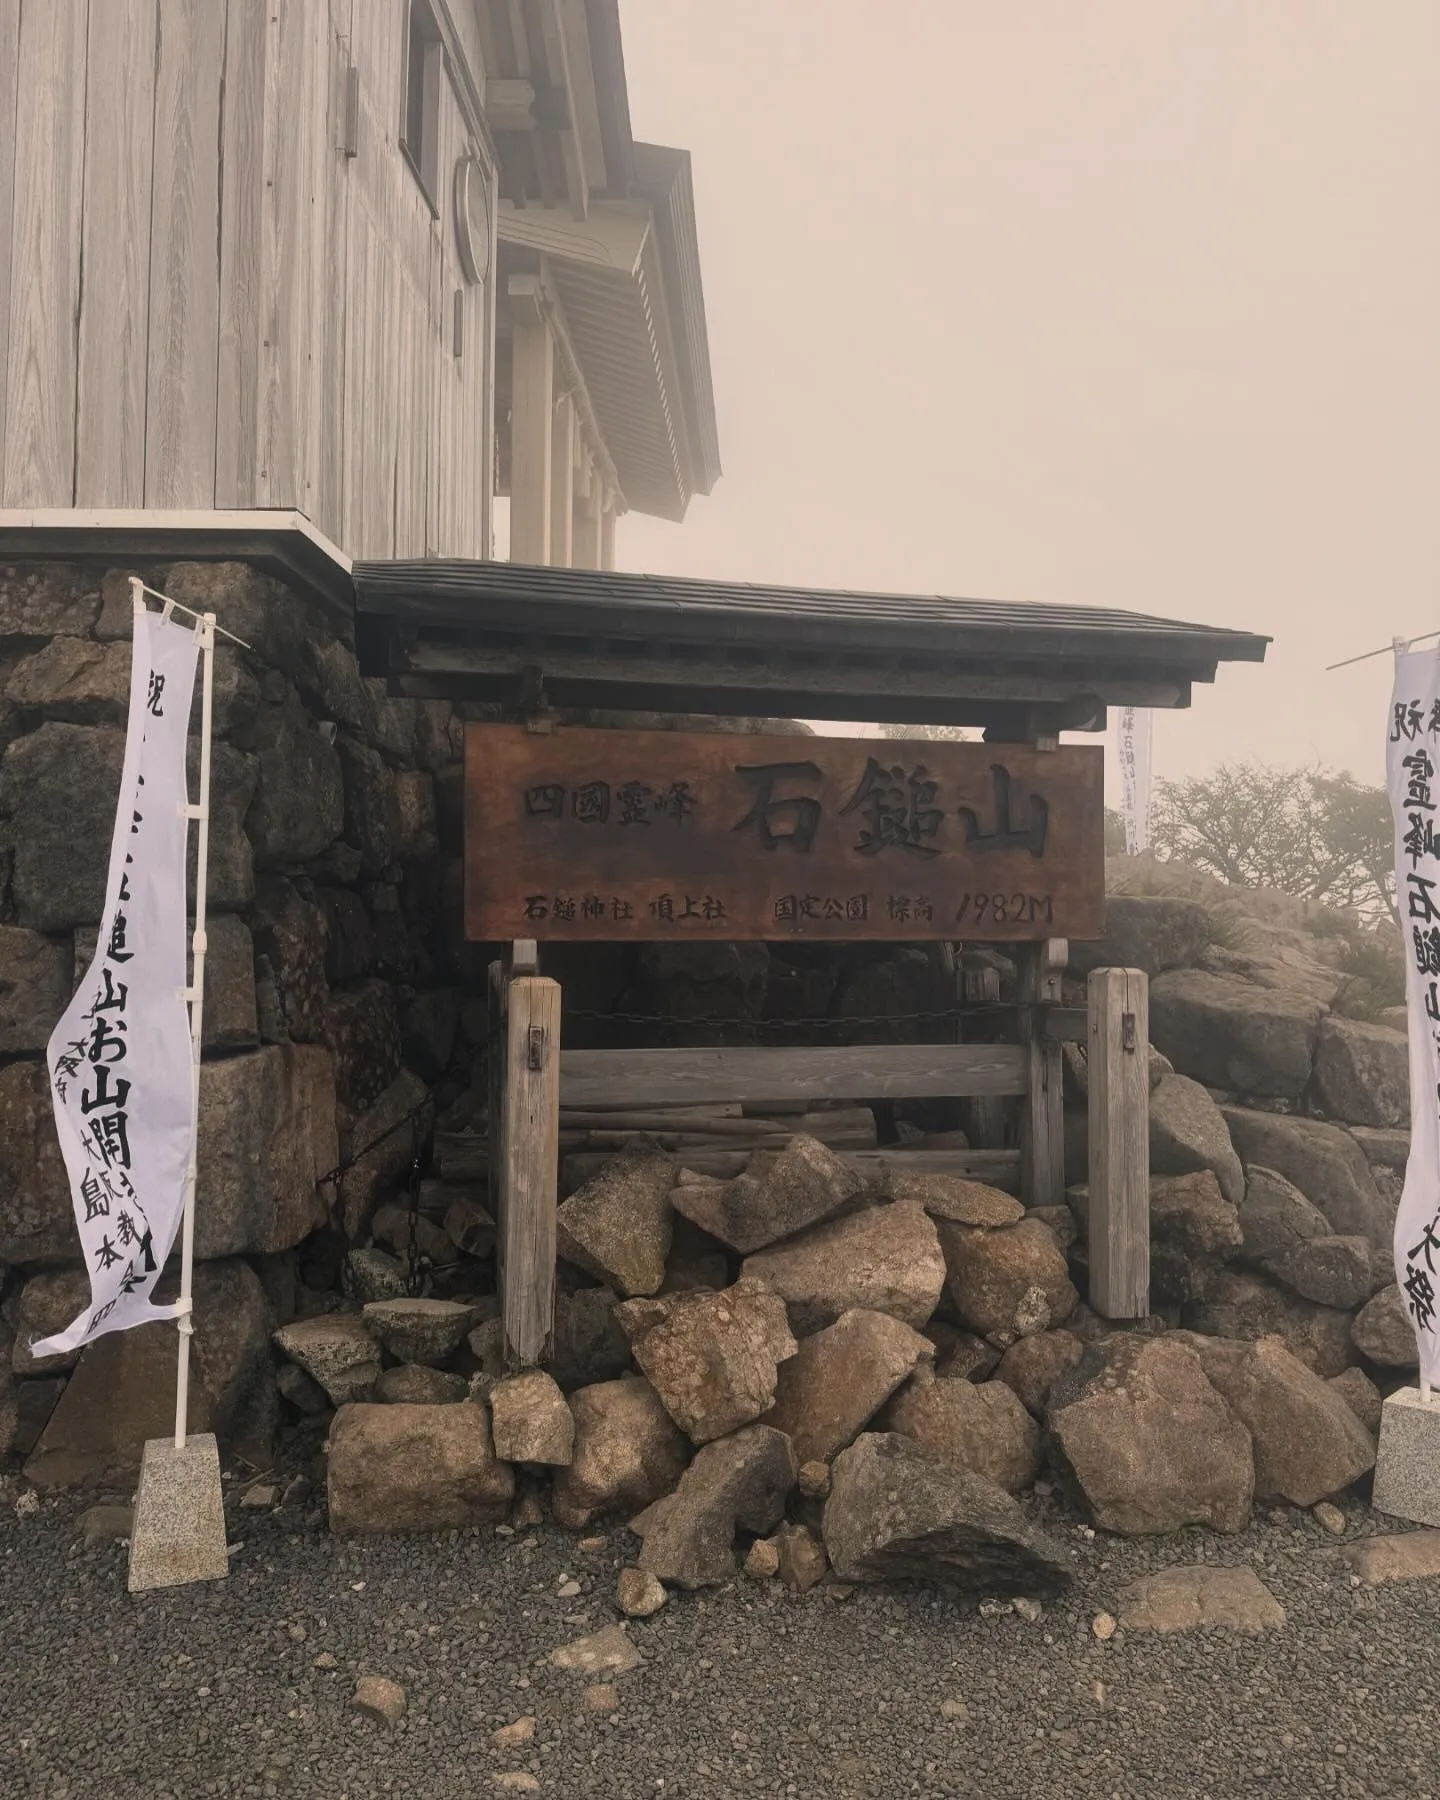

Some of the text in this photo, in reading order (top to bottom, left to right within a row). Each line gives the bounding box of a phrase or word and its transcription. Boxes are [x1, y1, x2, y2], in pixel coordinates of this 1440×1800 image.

[730, 756, 1049, 859] 石鎚山
[523, 894, 1054, 925] 石鎚神社 頂上社 国定公園 標高 1982M
